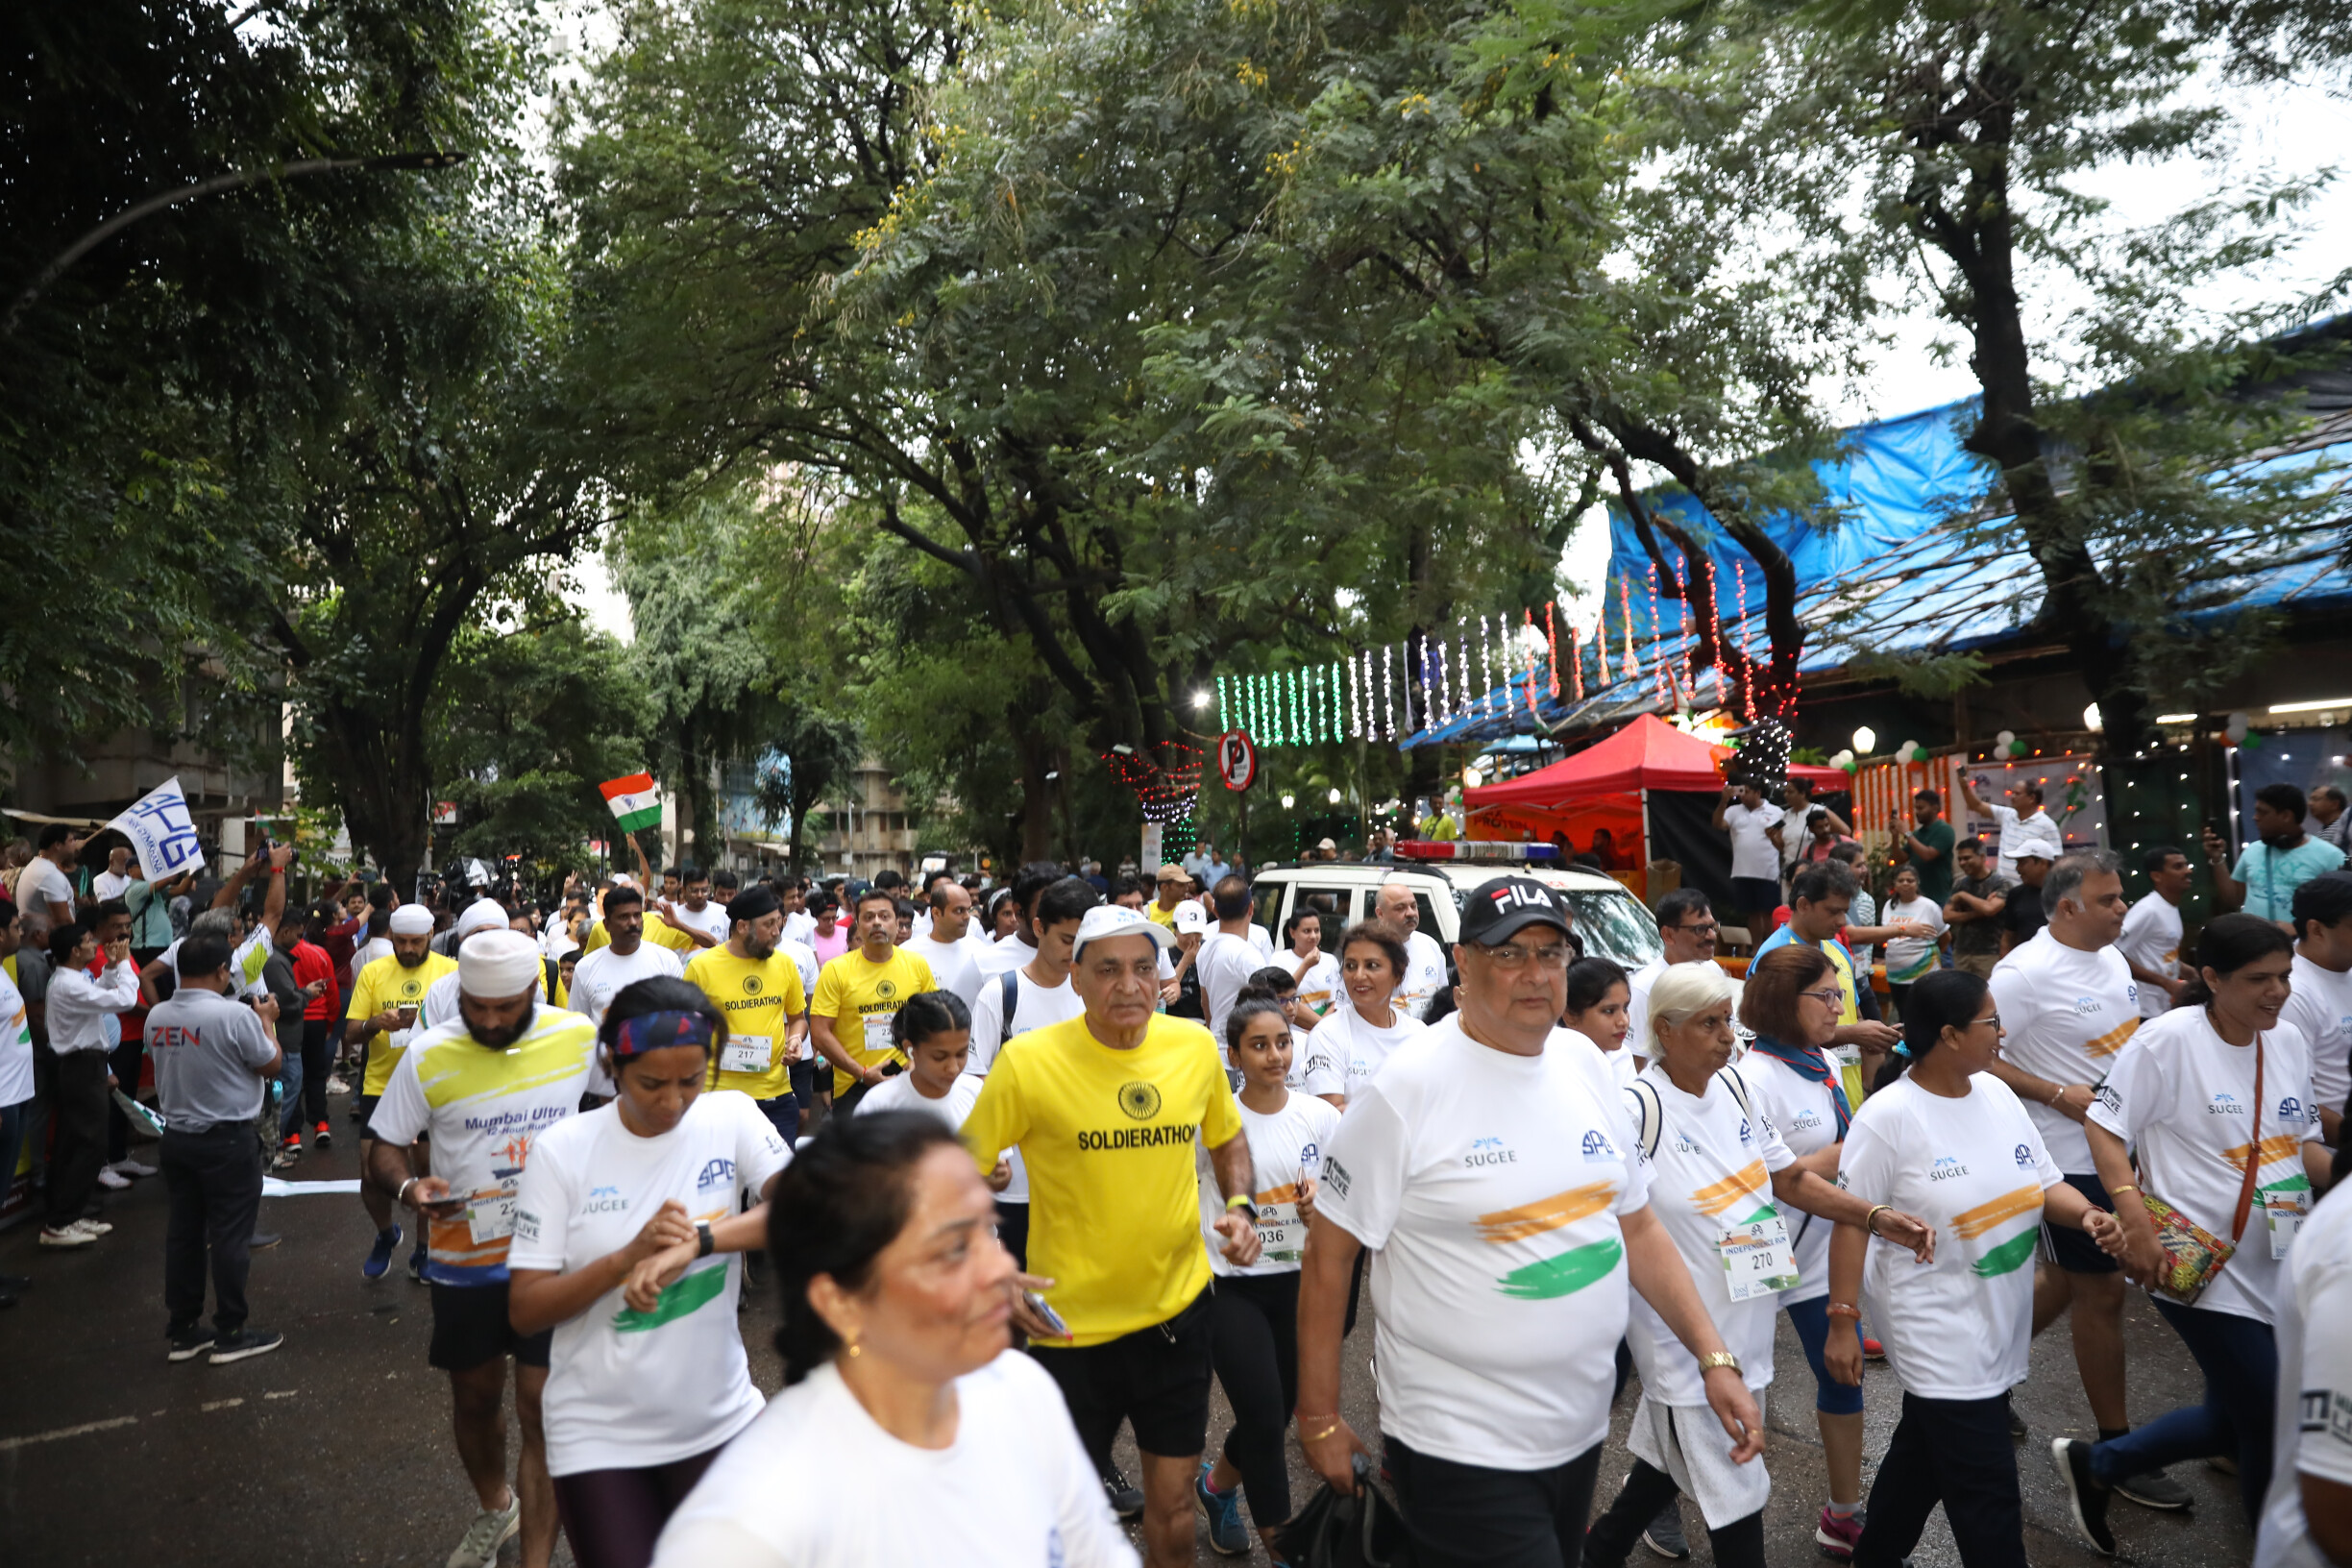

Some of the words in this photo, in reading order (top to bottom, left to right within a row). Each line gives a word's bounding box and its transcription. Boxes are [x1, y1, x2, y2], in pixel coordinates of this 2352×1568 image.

[1227, 740, 1245, 779] P
[1490, 885, 1553, 915] FILA
[1189, 912, 1198, 921] 3
[382, 999, 423, 1010] SOLDIERAT
[725, 995, 782, 1011] SOLDIERATHON
[858, 999, 909, 1014] SOLDIERAT
[151, 1026, 201, 1047] ZEN
[738, 1050, 754, 1059] 217
[2209, 1104, 2243, 1115] SUGEE
[465, 1110, 528, 1131] Mumbai
[531, 1107, 567, 1120] Ultra
[1793, 1117, 1823, 1131] SUGEE
[1465, 1150, 1518, 1168] SUGEE
[1929, 1164, 1971, 1182] SUGEE
[1329, 1169, 1350, 1197] LIVE
[471, 1189, 517, 1208] INDEPENDE
[1726, 1237, 1775, 1256] INDEPENDENCE
[1775, 1236, 1787, 1245] RUN
[1752, 1251, 1774, 1270] 270
